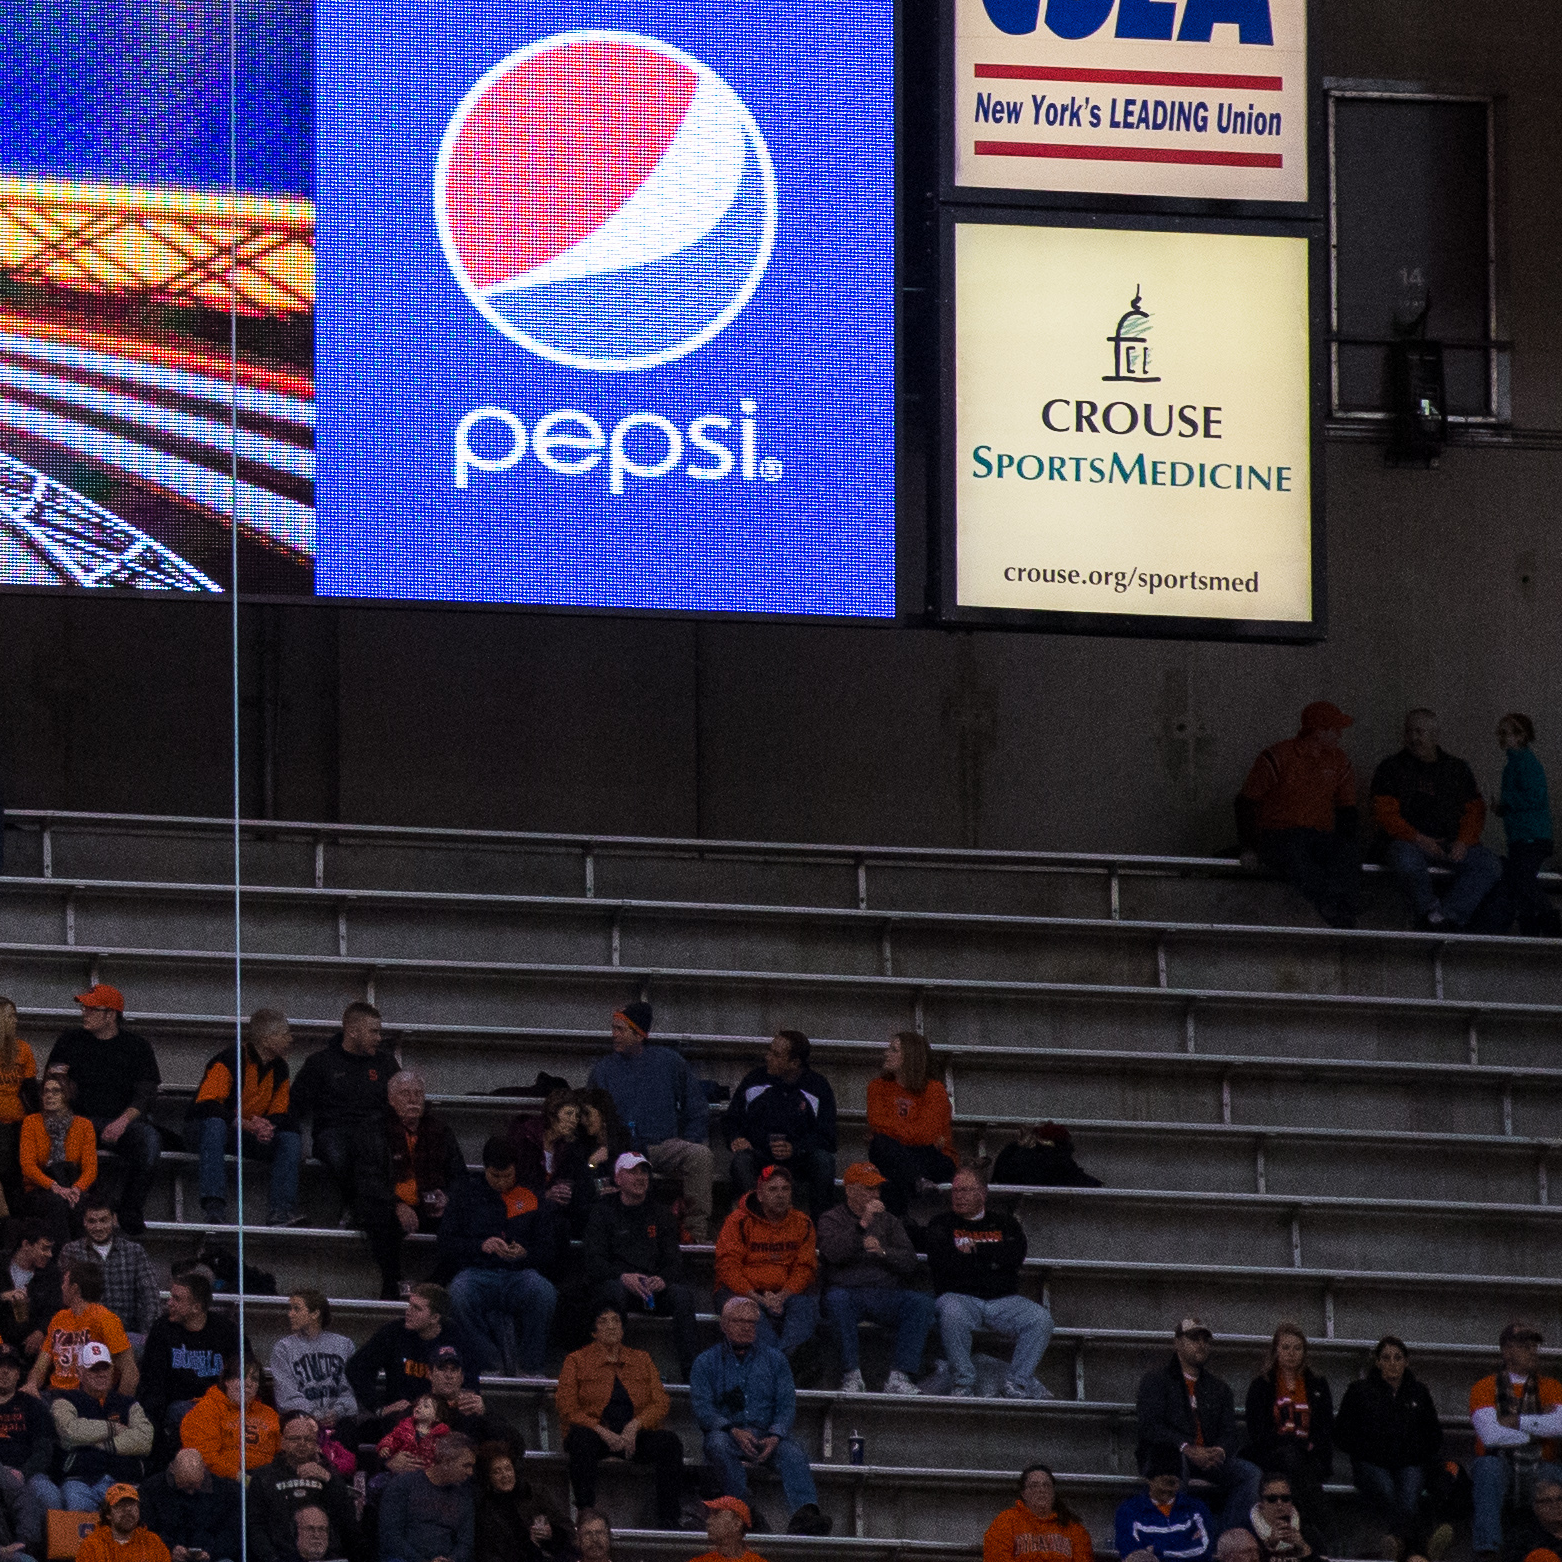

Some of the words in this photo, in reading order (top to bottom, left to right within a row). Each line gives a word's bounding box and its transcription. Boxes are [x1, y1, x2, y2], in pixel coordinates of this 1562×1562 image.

[973, 91, 1024, 125] New
[1031, 94, 1102, 129] York's
[1109, 97, 1210, 133] LEADING
[1216, 102, 1283, 137] Union
[1041, 397, 1223, 440] CROUSE
[453, 396, 758, 495] pepsi
[1002, 565, 1261, 595] crouse.org/sportsmed
